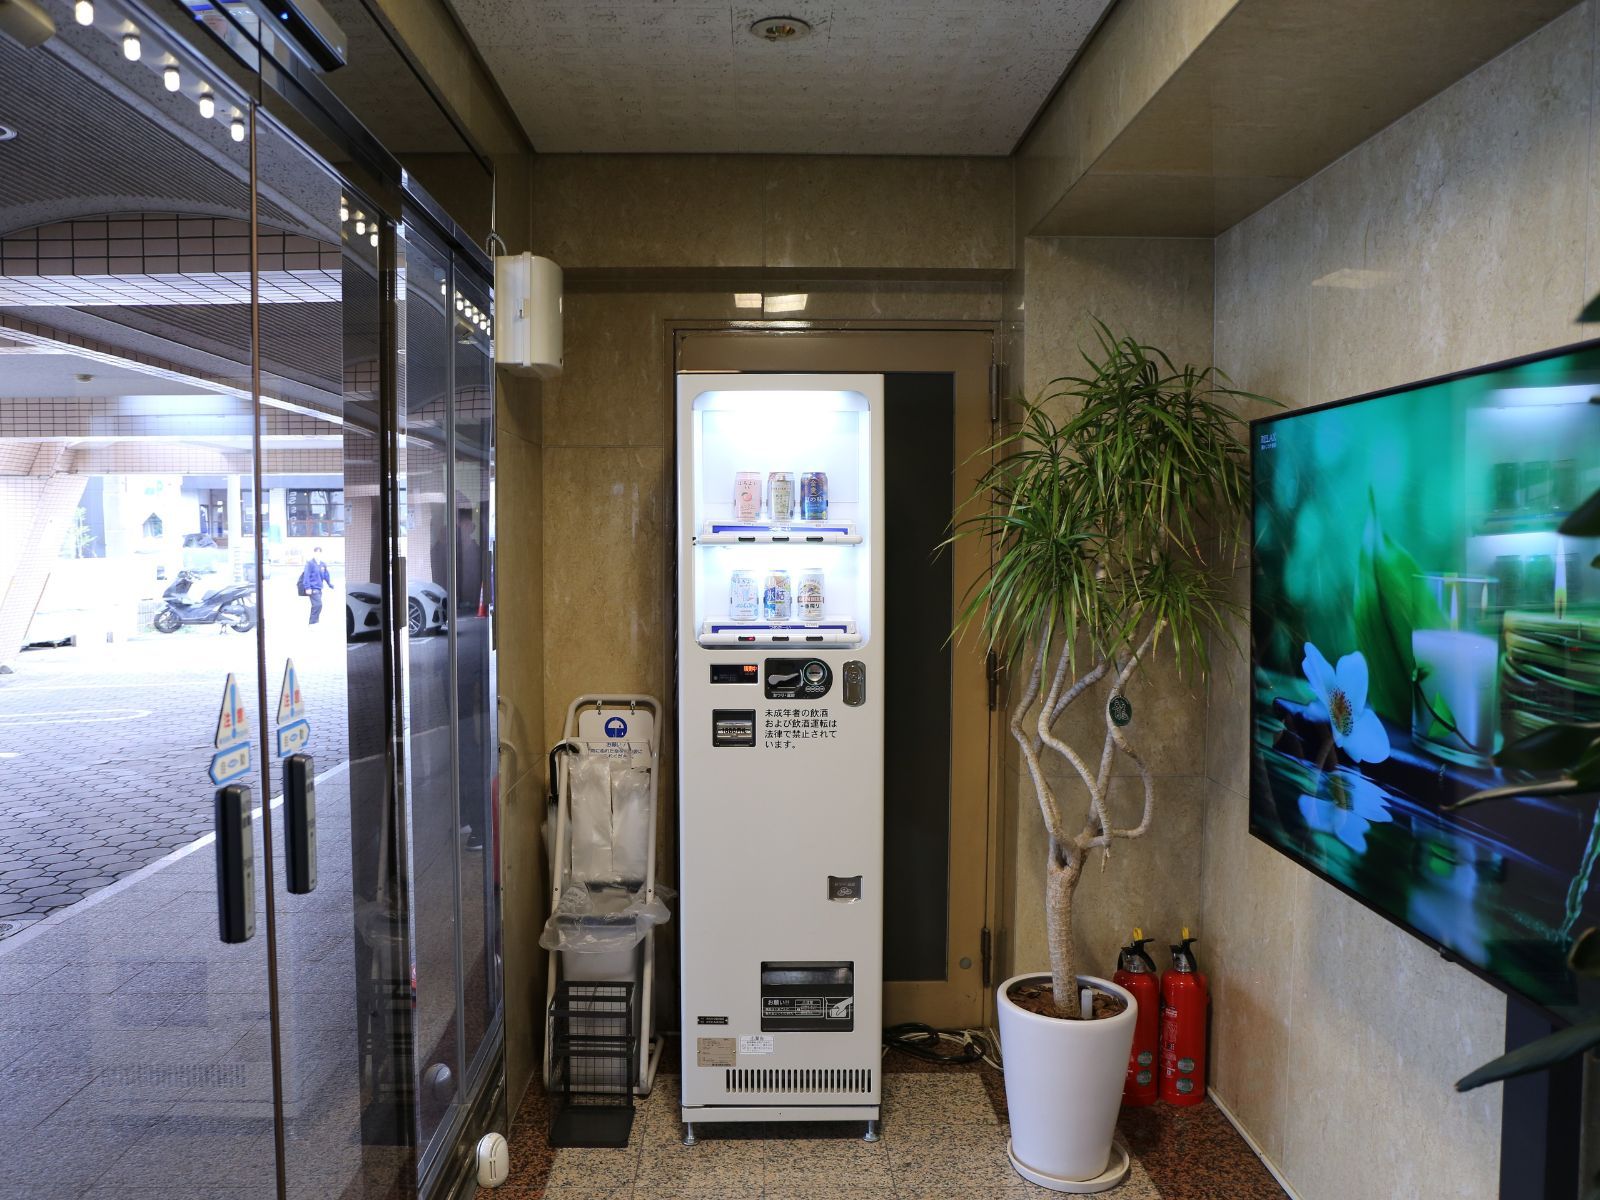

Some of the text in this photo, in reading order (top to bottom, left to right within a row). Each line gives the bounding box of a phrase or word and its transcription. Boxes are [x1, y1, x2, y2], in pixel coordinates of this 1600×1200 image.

[765, 708, 829, 718] 未成年者の飲酒
[765, 719, 838, 728] および飲酒運転は
[765, 730, 837, 739] 法律で禁止されて
[765, 740, 796, 749] います。
